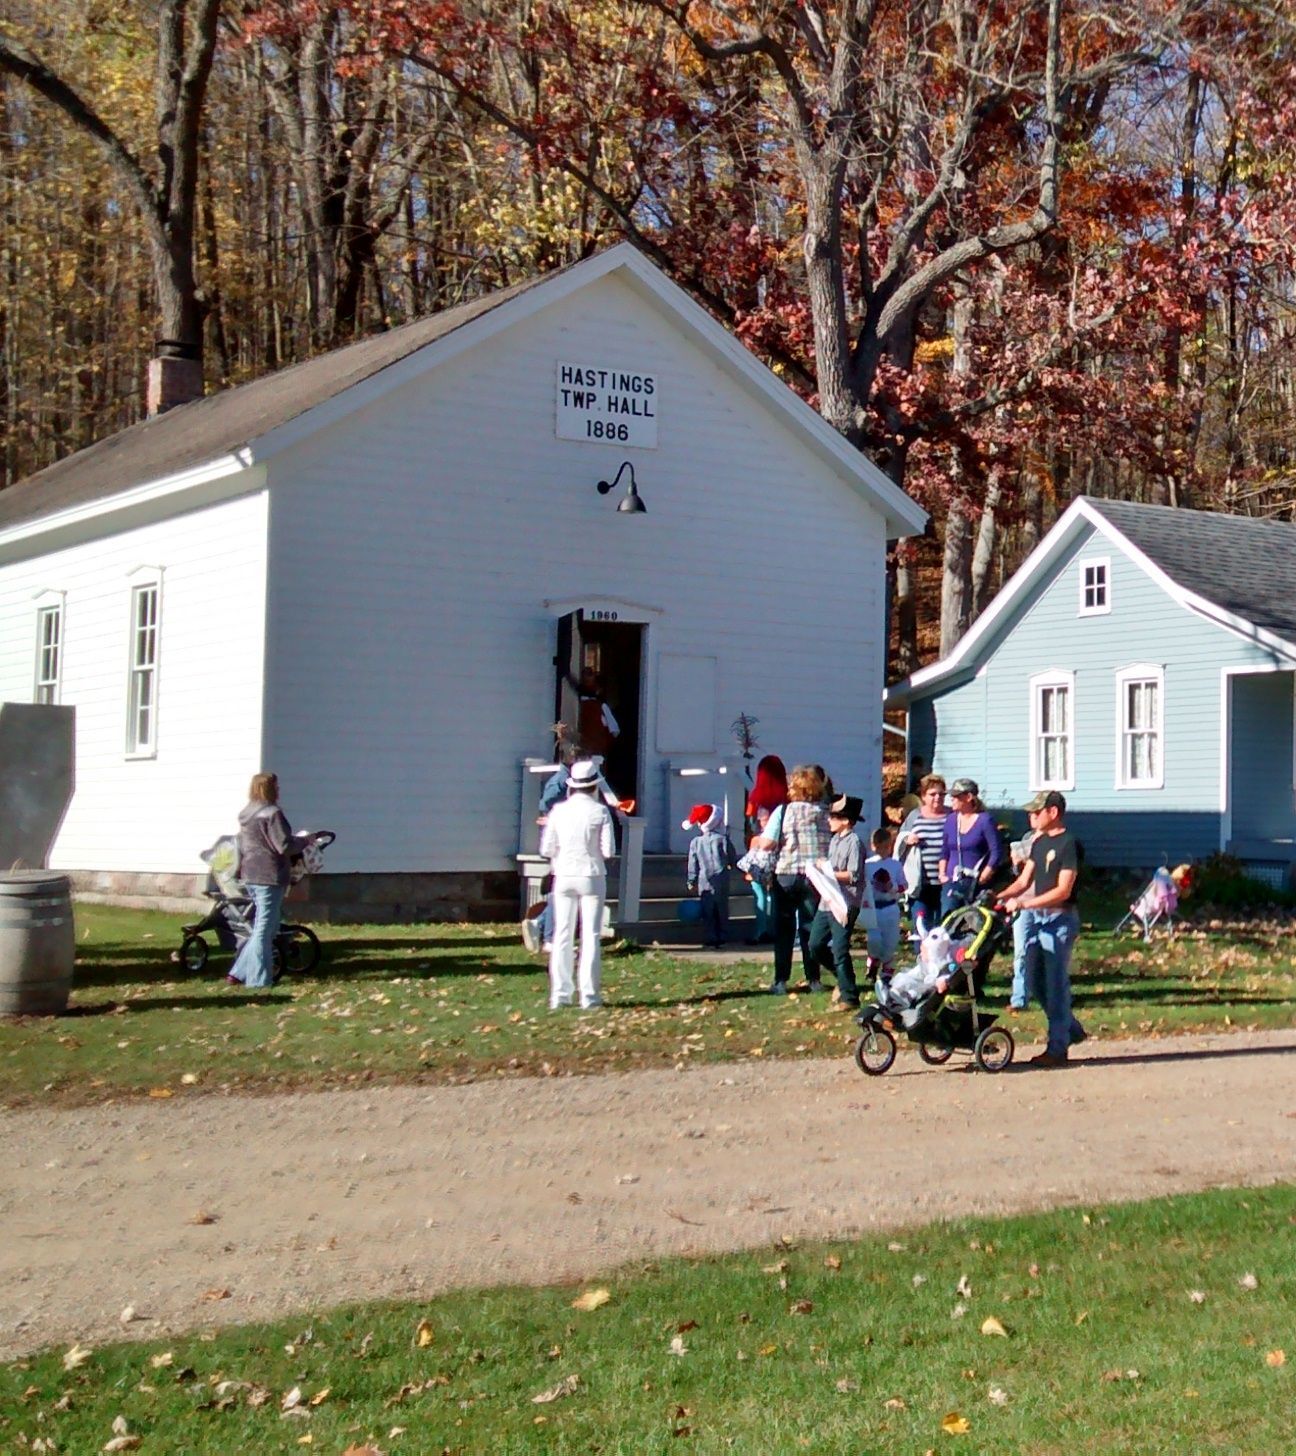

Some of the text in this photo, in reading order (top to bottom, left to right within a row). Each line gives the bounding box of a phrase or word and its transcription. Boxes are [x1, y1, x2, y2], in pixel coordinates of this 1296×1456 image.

[561, 366, 655, 395] HASTINGS
[560, 389, 655, 418] TWP. HALL
[586, 420, 629, 441] 1886
